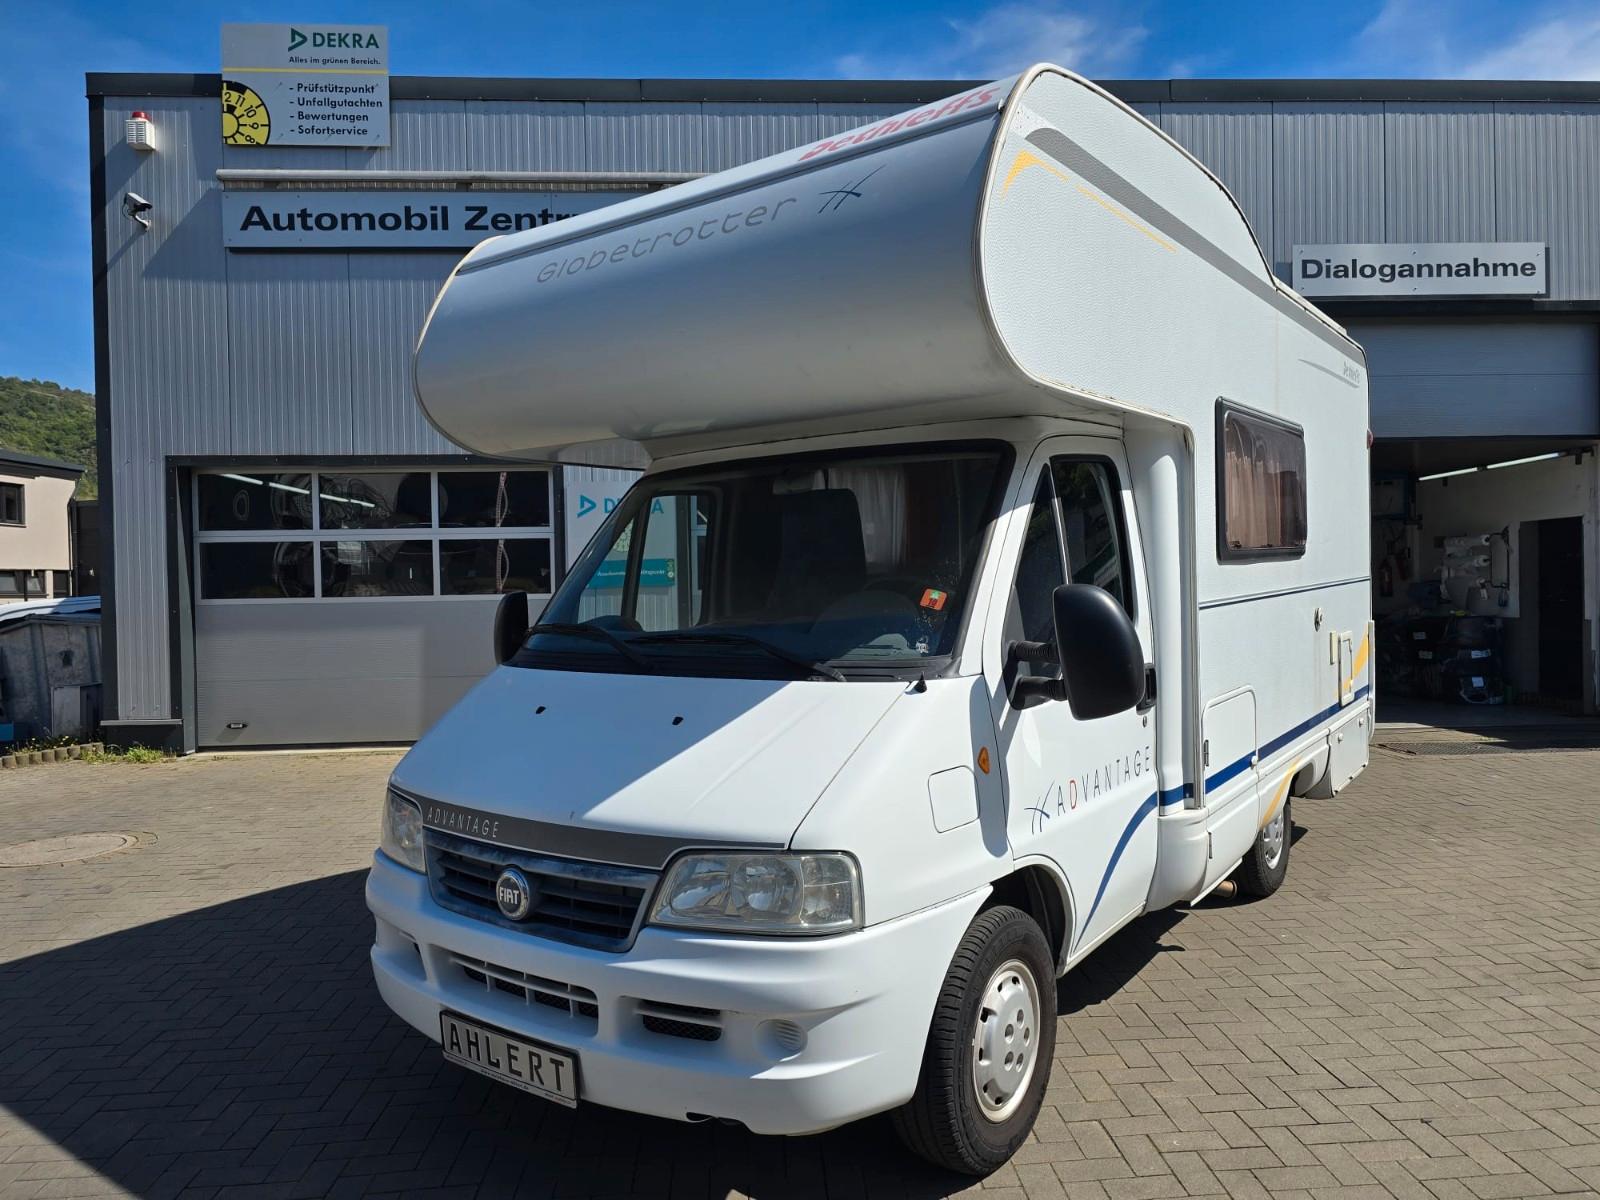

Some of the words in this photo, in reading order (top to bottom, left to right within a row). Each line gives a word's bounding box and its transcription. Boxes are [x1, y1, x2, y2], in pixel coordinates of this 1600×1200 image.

[312, 32, 380, 49] DEKRA
[289, 56, 308, 64] Alles
[322, 57, 349, 66] grünen
[351, 57, 381, 65] Bereich.
[297, 83, 376, 96] Prüfstützpunkt
[235, 94, 246, 107] 11
[297, 98, 383, 110] Unfallgutachten
[244, 104, 257, 119] 10
[298, 111, 369, 123] Bewertungen
[298, 125, 368, 136] Sofortservice
[245, 134, 256, 144] 8
[240, 205, 450, 232] Automobil
[464, 205, 580, 231] Zentr
[536, 197, 797, 284] Globetrotter
[1301, 257, 1537, 283] Dialogannahme
[1057, 745, 1150, 817] ADVANTAGE
[426, 806, 500, 839] ADVANTAGE
[499, 885, 520, 906] FIAT
[449, 1022, 565, 1092] AHLERT
